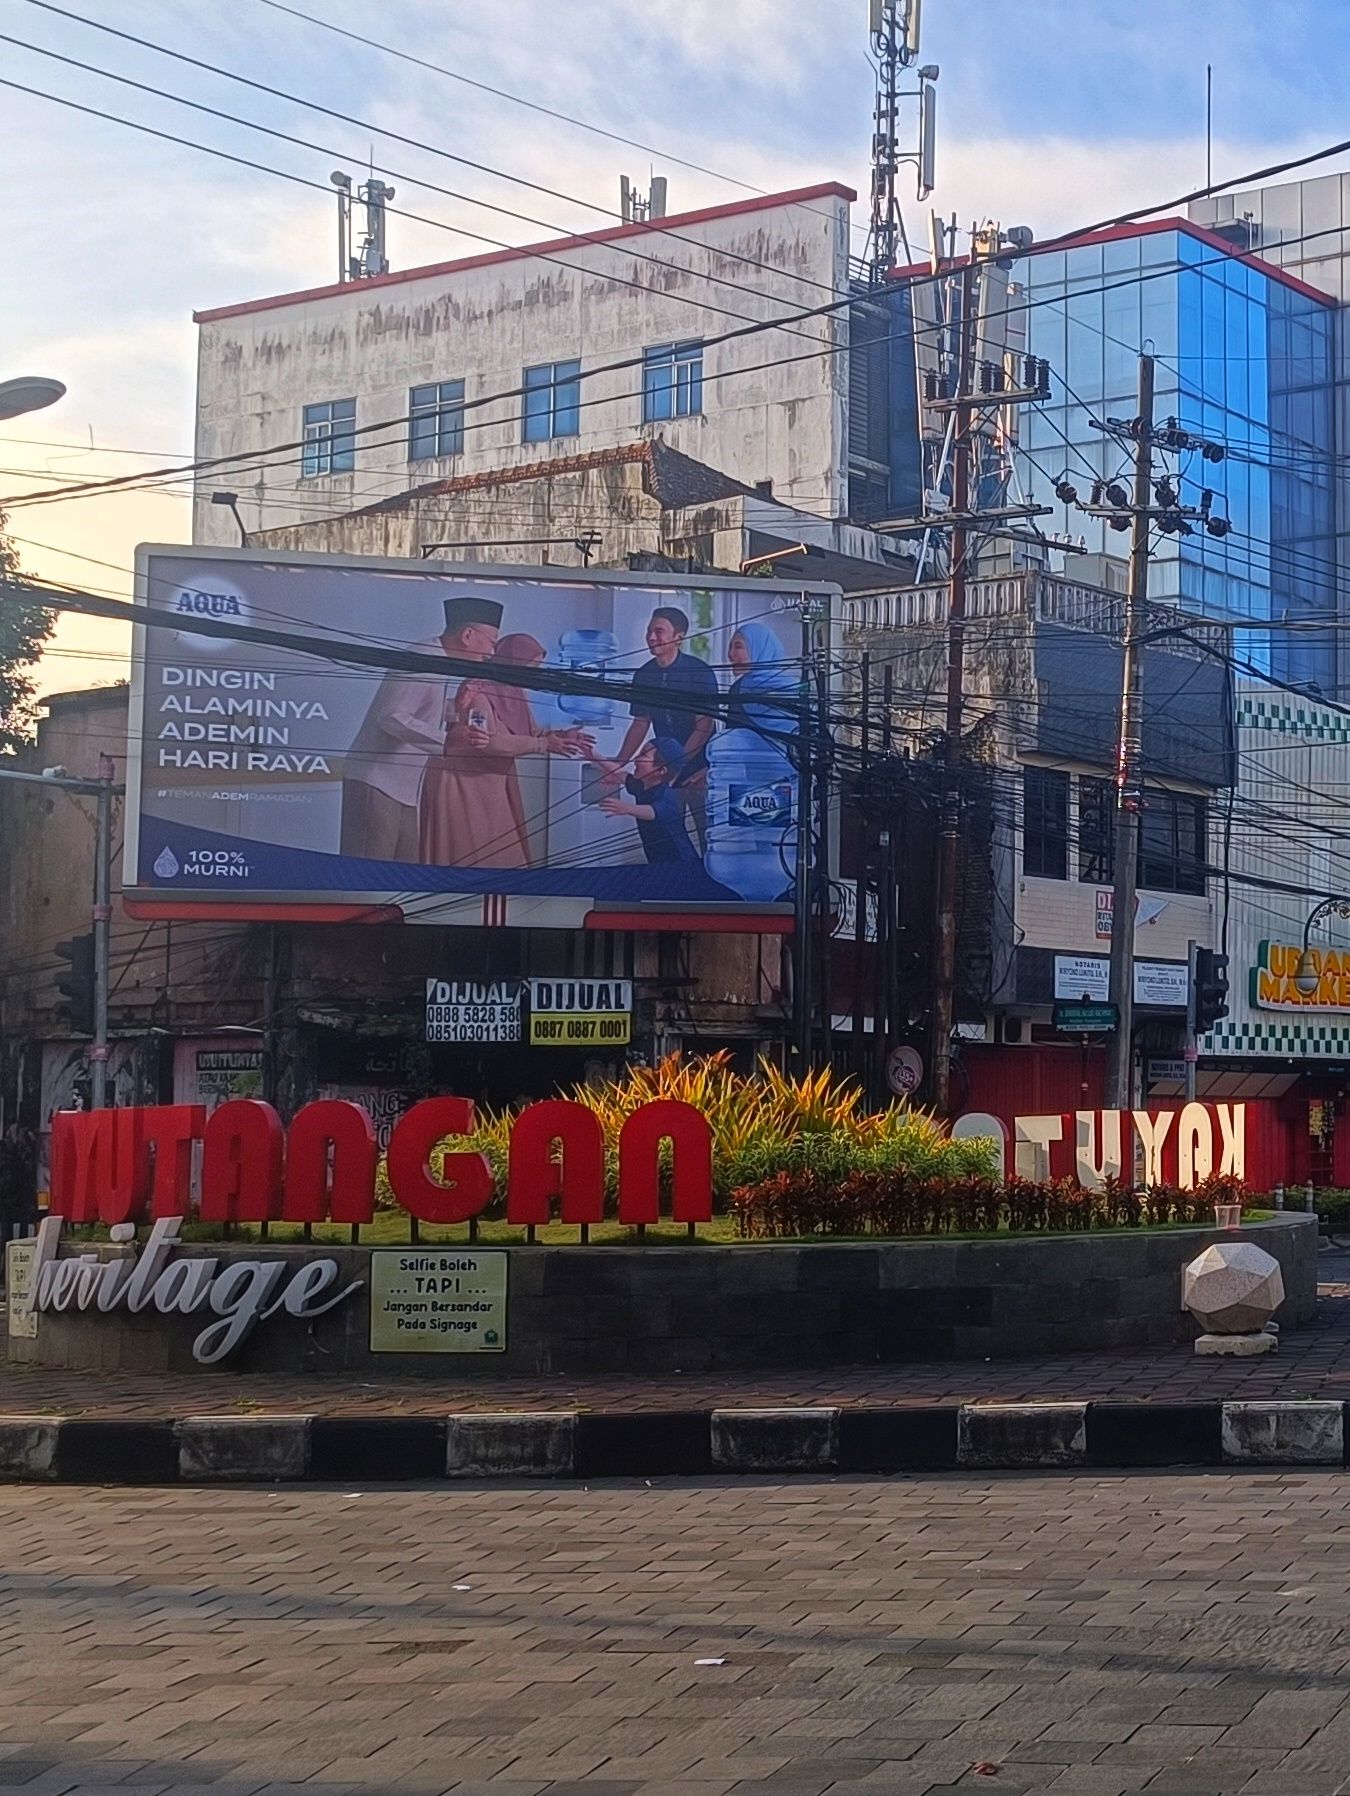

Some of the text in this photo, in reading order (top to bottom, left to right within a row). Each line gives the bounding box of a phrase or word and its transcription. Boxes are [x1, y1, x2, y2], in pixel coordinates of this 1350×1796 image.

[176, 592, 241, 617] AQUA
[162, 667, 276, 690] DINGIN
[159, 695, 329, 720] ALAMINYA
[158, 722, 289, 745] ADEMIN
[159, 749, 331, 774] HARI RAYA
[743, 796, 778, 812] AQUA
[189, 850, 246, 864] 100%
[437, 982, 514, 1004] DIJUAL
[537, 983, 625, 1010] DIJUAL
[428, 1007, 460, 1023] 0888
[463, 1007, 496, 1023] 5828
[600, 1021, 627, 1038] 0001
[400, 1259, 477, 1271] Selfie Boleh
[415, 1278, 460, 1293] TAPI
[383, 1301, 493, 1315] Jangan Bersandar
[397, 1318, 478, 1333] Pada Signage
